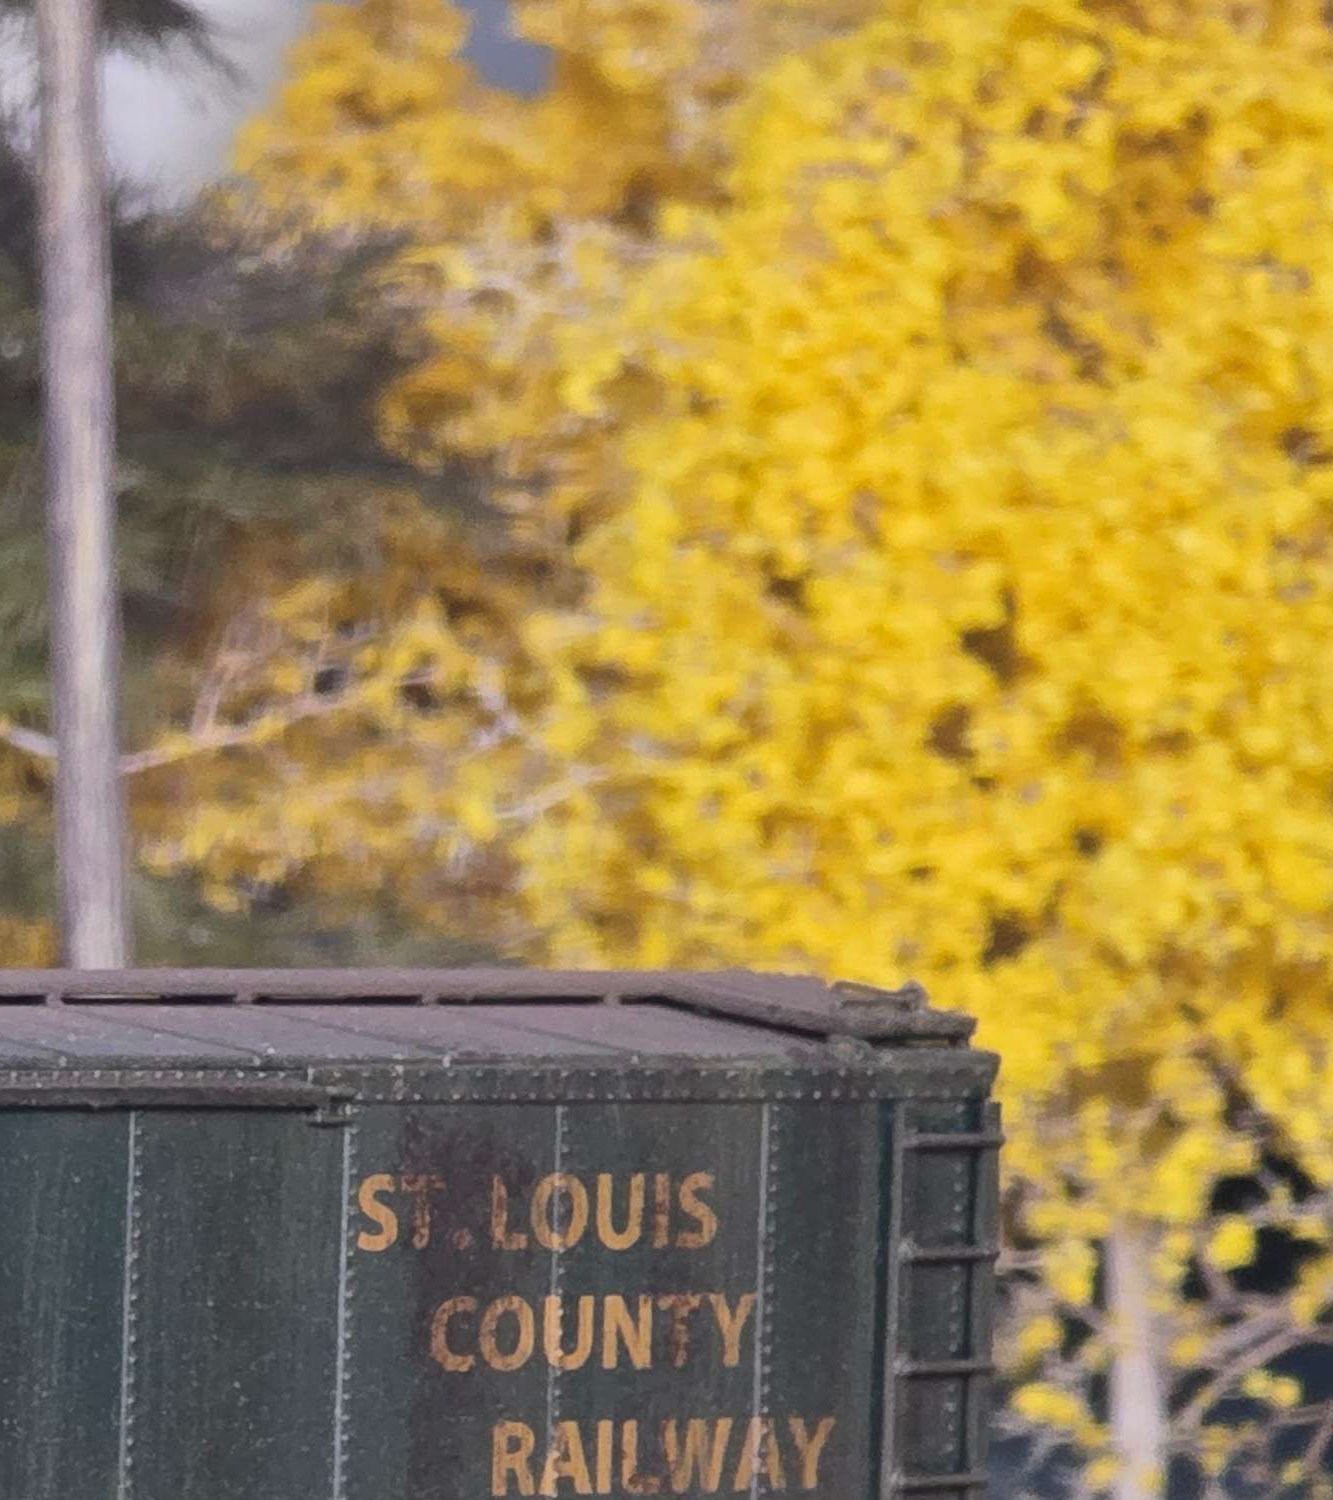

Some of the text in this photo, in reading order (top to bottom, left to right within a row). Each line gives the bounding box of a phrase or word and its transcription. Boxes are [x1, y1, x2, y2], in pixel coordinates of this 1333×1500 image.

[356, 1171, 718, 1253] ST. LOUIS
[432, 1292, 758, 1372] COUNTY
[489, 1415, 836, 1498] RAILWAY
